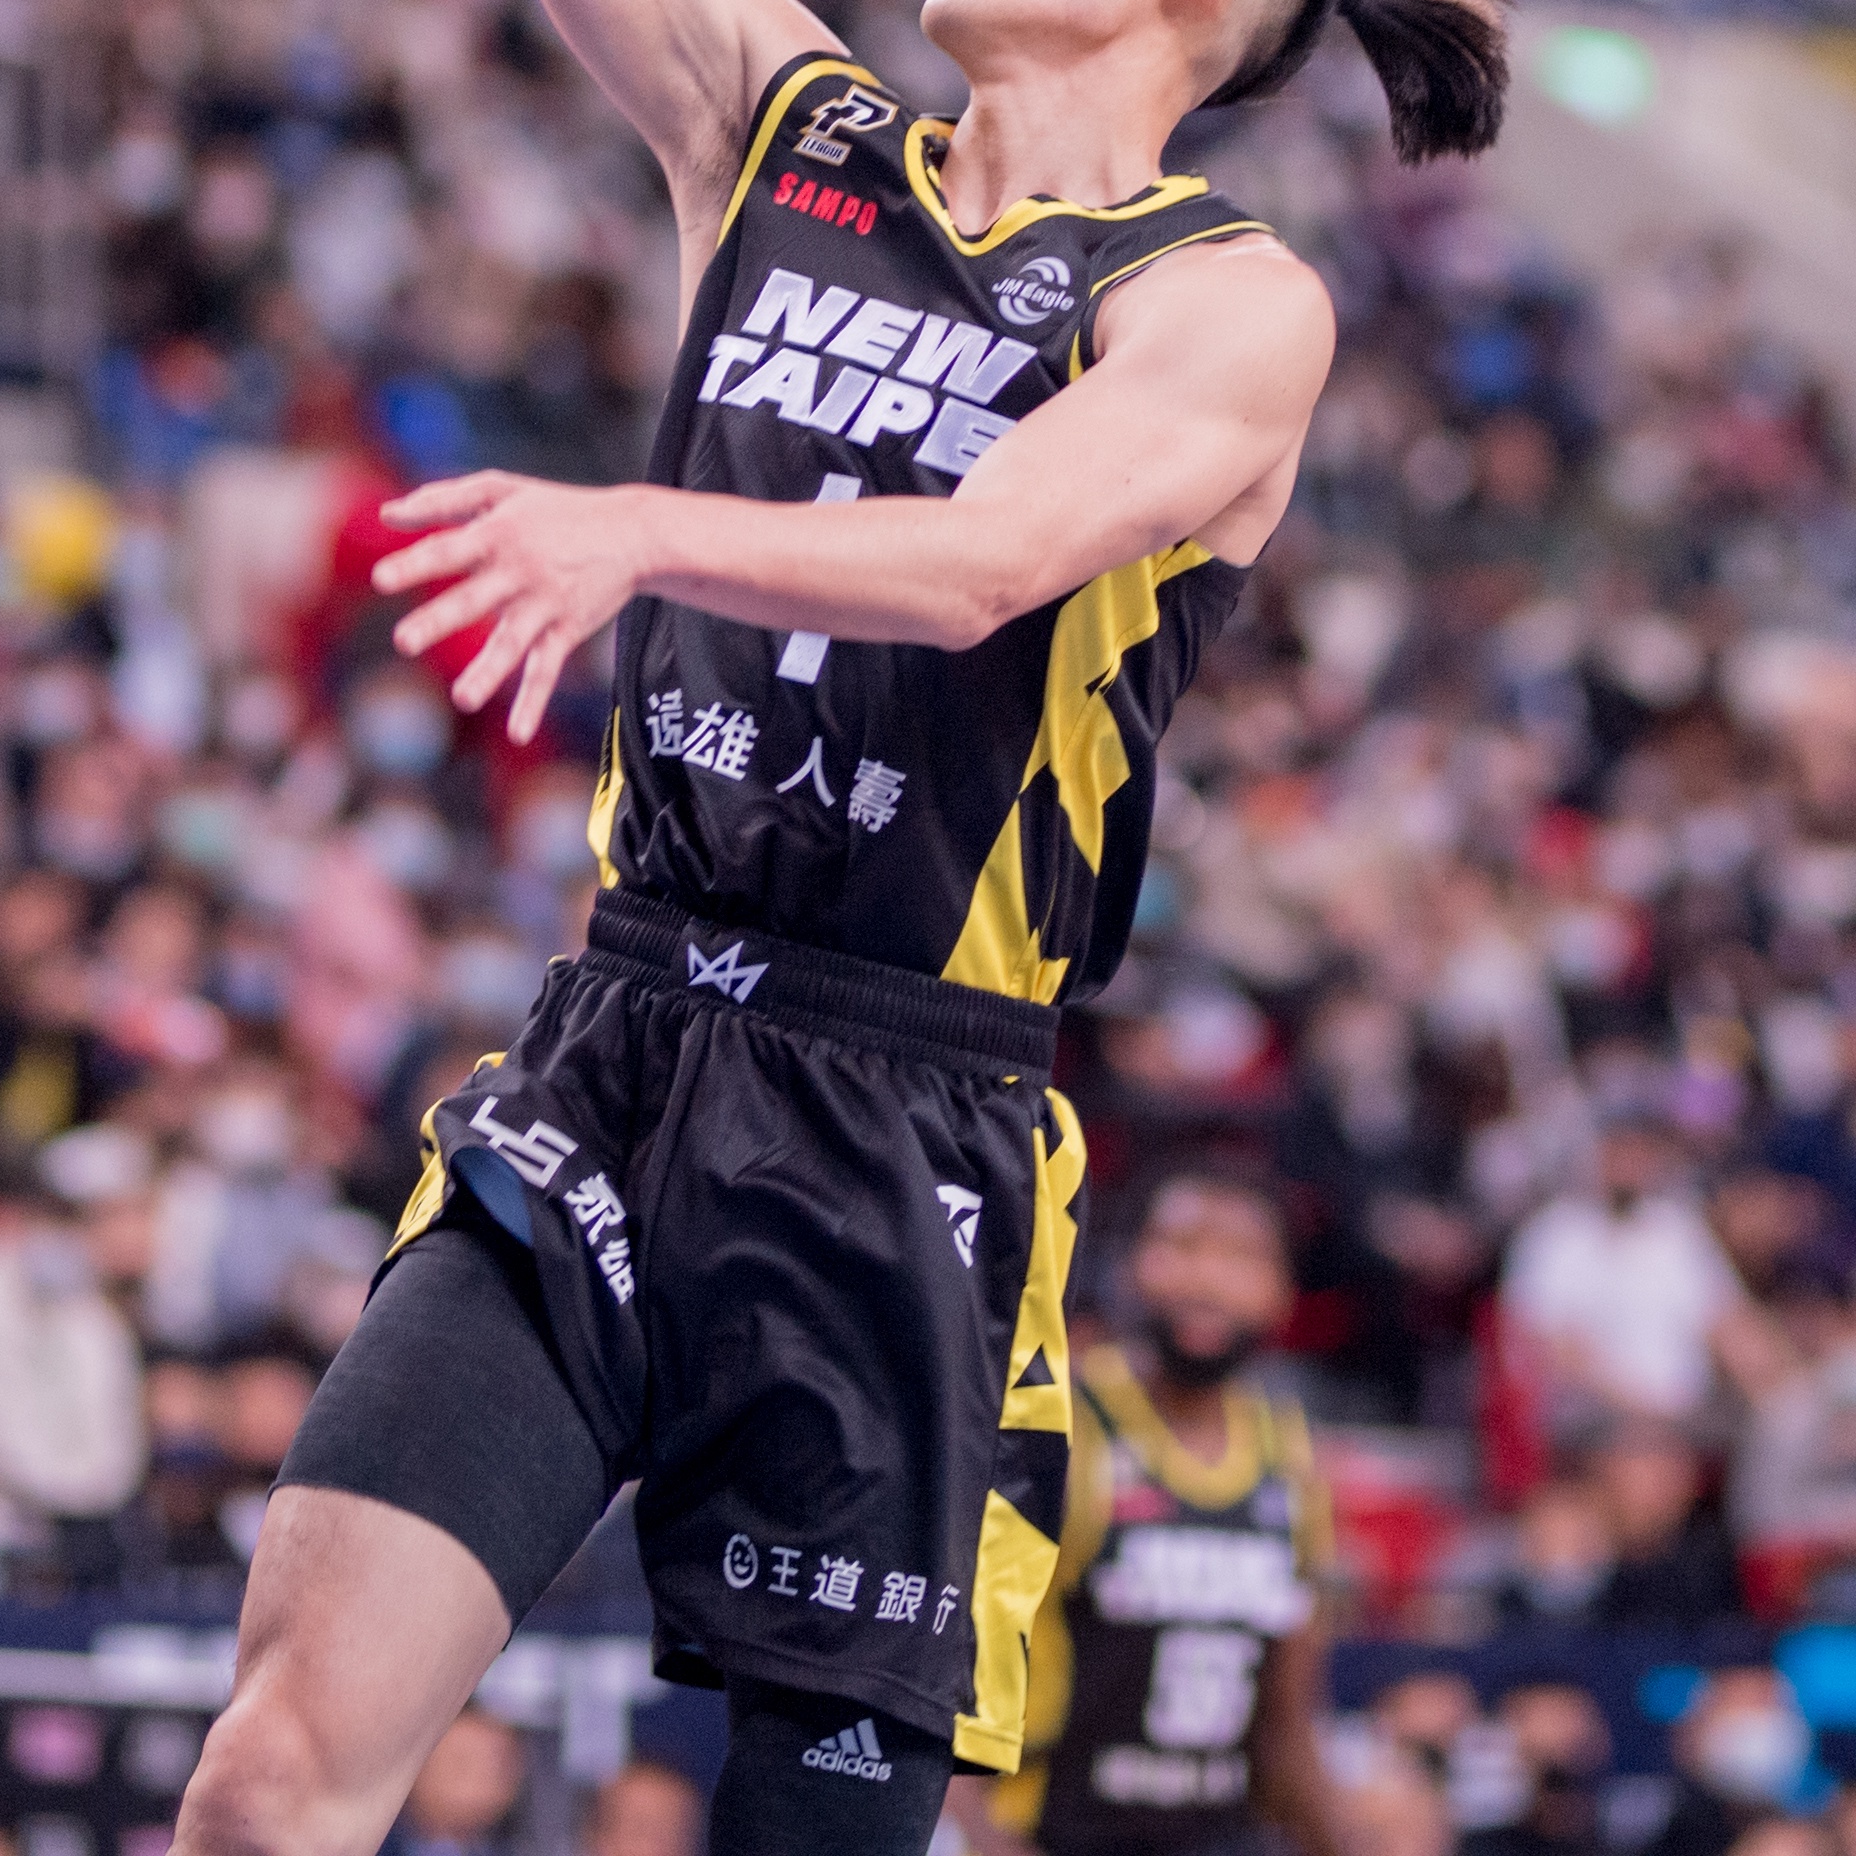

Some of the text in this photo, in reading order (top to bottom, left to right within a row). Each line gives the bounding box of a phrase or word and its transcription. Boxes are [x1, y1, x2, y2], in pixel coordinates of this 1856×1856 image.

[773, 171, 878, 236] SAMPO
[991, 277, 1075, 312] JM Eagle
[741, 267, 1038, 406] NEW
[801, 1747, 893, 1782] adidas
